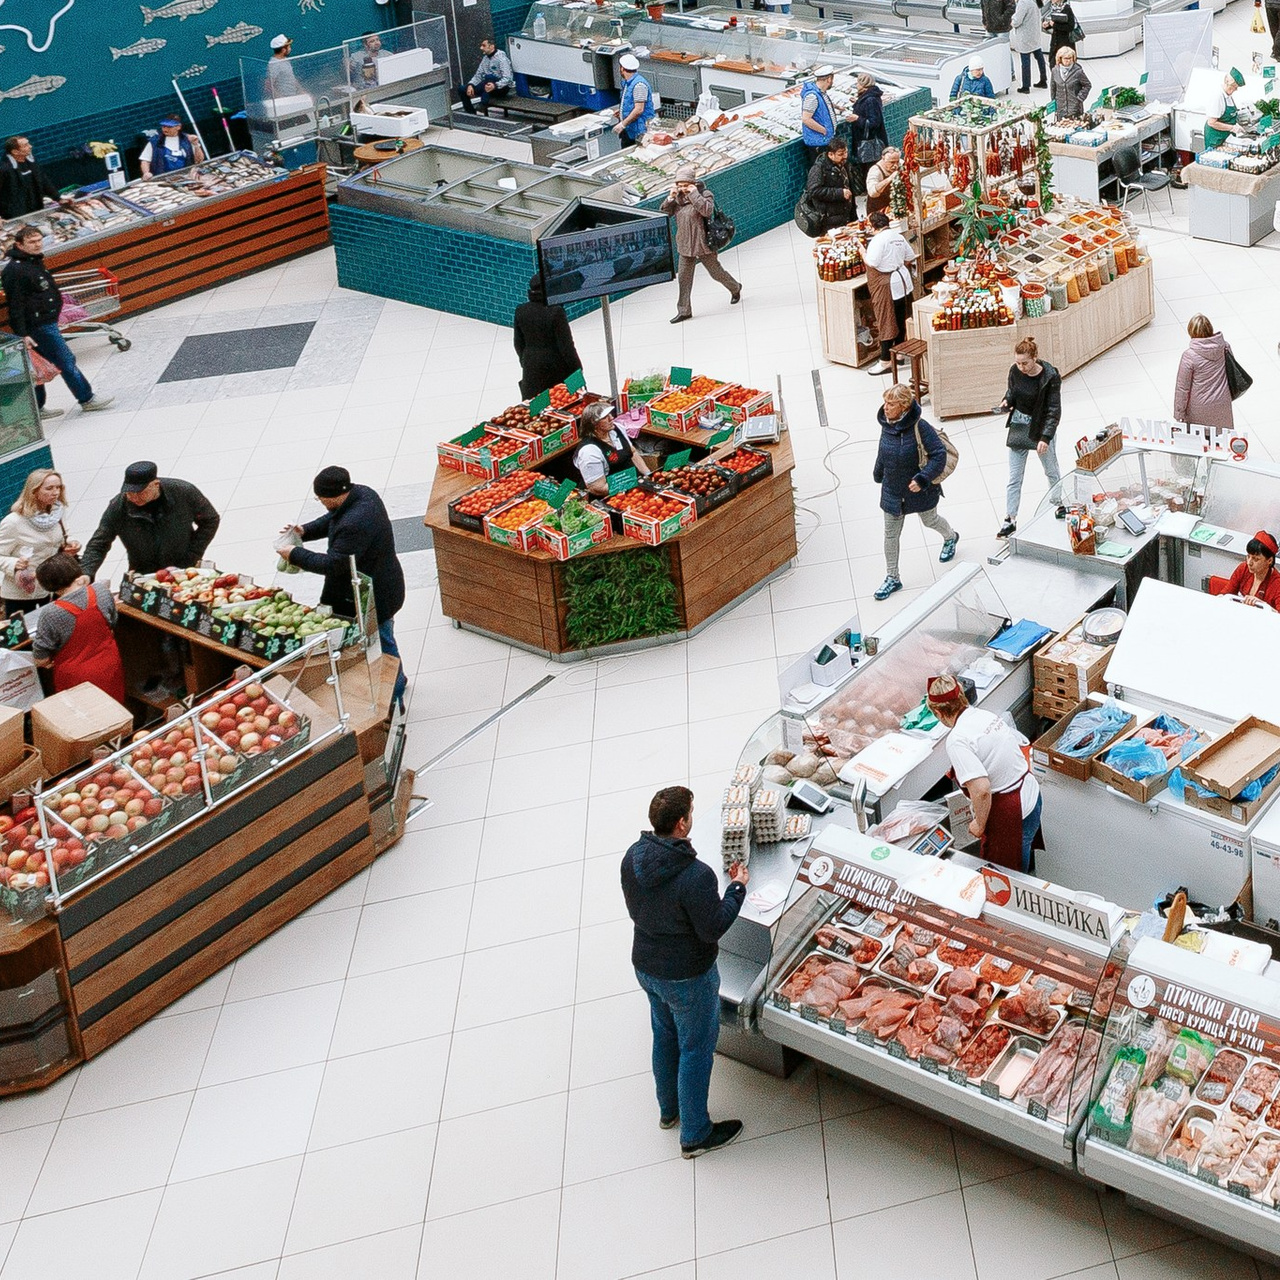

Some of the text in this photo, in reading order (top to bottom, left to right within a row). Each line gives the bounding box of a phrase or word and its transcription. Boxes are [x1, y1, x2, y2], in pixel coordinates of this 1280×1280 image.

[1210, 840, 1244, 858] 46-43-98
[833, 881, 896, 914] МЯСО ИНДЕЙКИ
[838, 864, 892, 896] ПТИЧКИН
[1014, 886, 1109, 940] ИНДЕЙКА
[1158, 1004, 1265, 1053] МЯСО КУРИЦЫ И УТКИ
[1163, 983, 1260, 1033] ПТИЧКИН ДОМ
